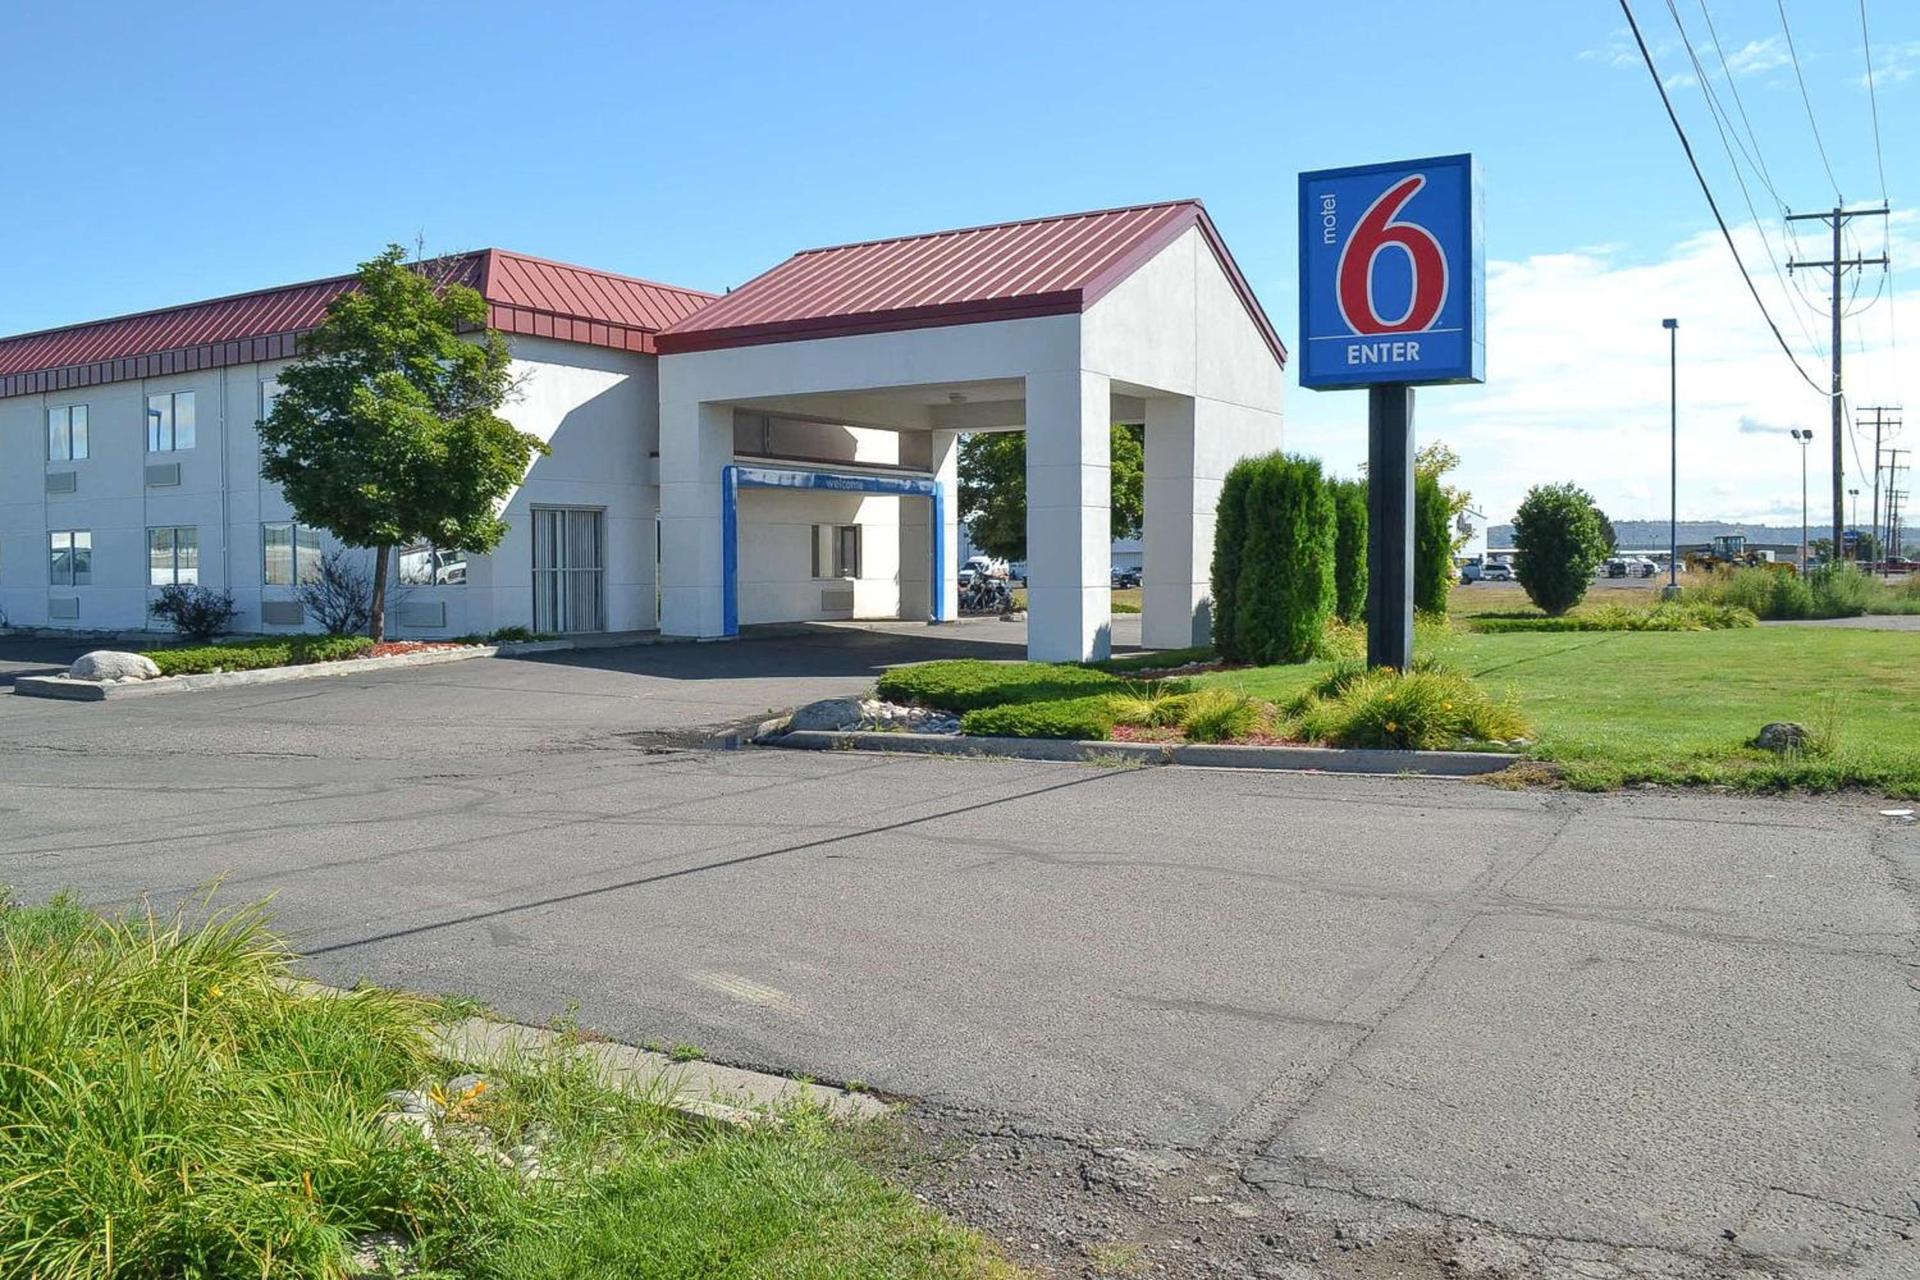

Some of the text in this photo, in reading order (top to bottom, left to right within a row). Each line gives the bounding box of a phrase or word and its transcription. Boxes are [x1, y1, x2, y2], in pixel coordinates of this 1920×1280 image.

[1320, 194, 1336, 244] motel
[1336, 173, 1449, 336] 6
[1347, 341, 1420, 365] ENTER
